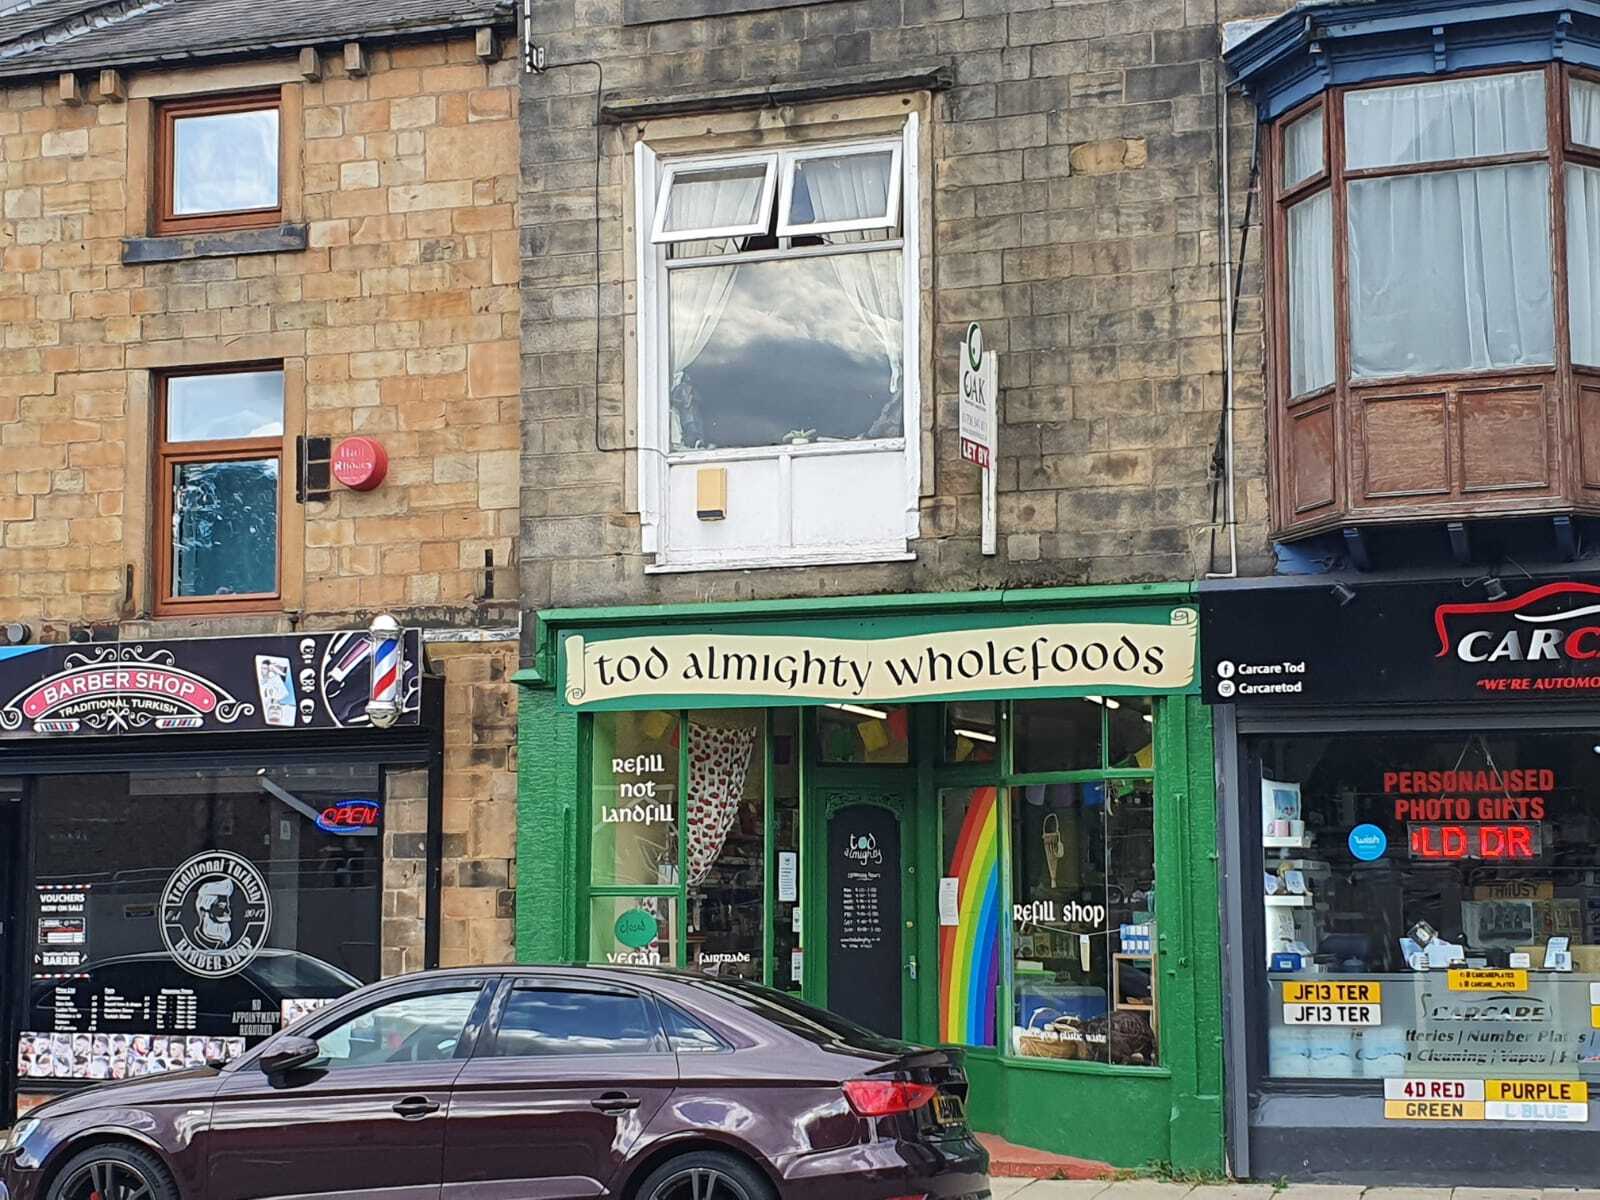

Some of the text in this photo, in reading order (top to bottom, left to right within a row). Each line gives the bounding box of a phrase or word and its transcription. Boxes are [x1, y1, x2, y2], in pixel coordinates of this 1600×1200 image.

[964, 371, 985, 406] OAK
[1457, 627, 1600, 663] CARC
[593, 635, 1165, 695] tod almighty wholefoods
[1238, 661, 1305, 675] Carcare Tod
[43, 671, 196, 704] BARBER SHOP
[1239, 681, 1302, 694] Carcaretod
[58, 699, 178, 717] TRADITIONAL TURKISH
[620, 780, 656, 798] not
[1383, 769, 1555, 793] PERSONALISED
[321, 807, 378, 826] OPEN
[1394, 797, 1545, 821] PHOTO GIFTS
[1479, 825, 1534, 857] DR
[168, 858, 263, 905] Traditional Turkish
[40, 893, 85, 903] VOUCHERS
[1063, 900, 1105, 928] shop
[43, 956, 80, 966] BARBER
[175, 938, 222, 970] BARBER
[1336, 984, 1369, 1000] TER
[232, 1011, 280, 1023] APPOINTMENT
[1337, 1006, 1370, 1022] TER
[239, 1024, 273, 1035] REQUIRED
[1467, 1032, 1530, 1042] Number
[1538, 1031, 1587, 1043] Plats
[1404, 1082, 1465, 1098] 4D RED
[1501, 1083, 1571, 1099] PURPLE
[1406, 1103, 1463, 1117] GREEN
[1521, 1104, 1568, 1118] BLUE
